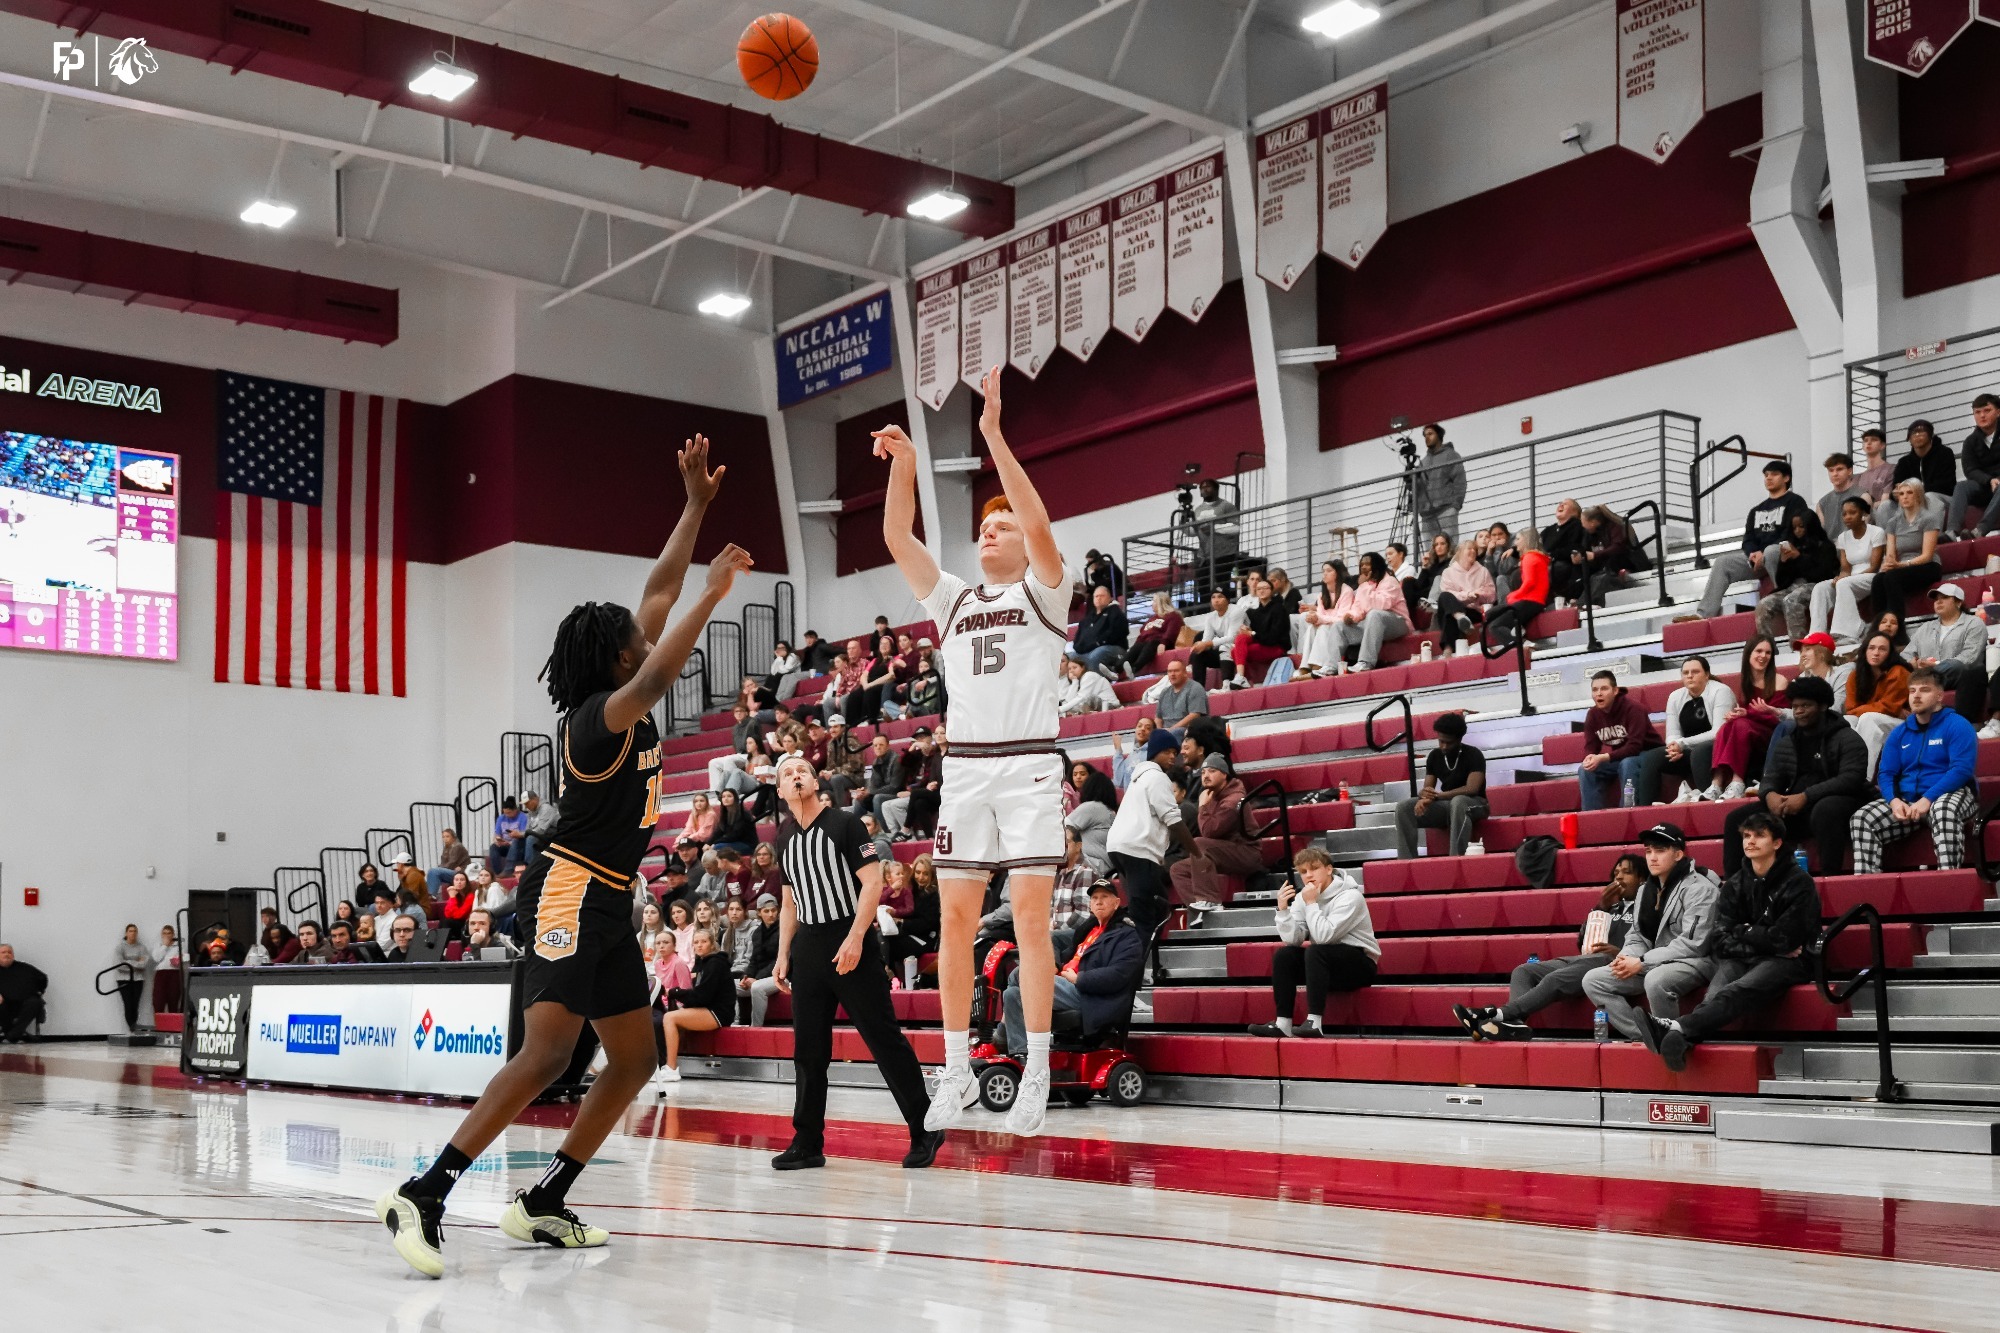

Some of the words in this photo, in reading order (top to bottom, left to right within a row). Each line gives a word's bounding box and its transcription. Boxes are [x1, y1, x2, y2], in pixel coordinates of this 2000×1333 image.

[1876, 8, 1911, 28] 2013
[1876, 20, 1911, 40] 2015
[1626, 59, 1655, 78] 2009
[1626, 70, 1654, 88] 2014
[1627, 81, 1655, 98] 2015
[1332, 91, 1376, 129] VALOR
[1266, 121, 1308, 154] VALOR
[1176, 161, 1214, 192] VALOR
[1120, 184, 1156, 215] VALOR
[1328, 186, 1351, 200] 2014
[1328, 197, 1351, 210] 2015
[1067, 208, 1101, 238] VALOR
[1177, 220, 1203, 237] FINAL
[786, 314, 849, 356] NCCAA
[866, 300, 882, 322] W
[796, 329, 872, 369] BASKETBALL
[799, 343, 869, 380] CHAMPIONS
[36, 373, 161, 413] ARENA
[955, 609, 1028, 636] EVANGEL
[972, 633, 1006, 675] 15
[197, 1032, 237, 1055] TROPHY
[260, 1023, 284, 1042] PAUL
[289, 1023, 337, 1045] MUELLER
[344, 1025, 397, 1047] COMPANY
[434, 1024, 502, 1056] Domino's
[1664, 1104, 1700, 1114] RESERVED
[1664, 1113, 1693, 1122] SEATING
